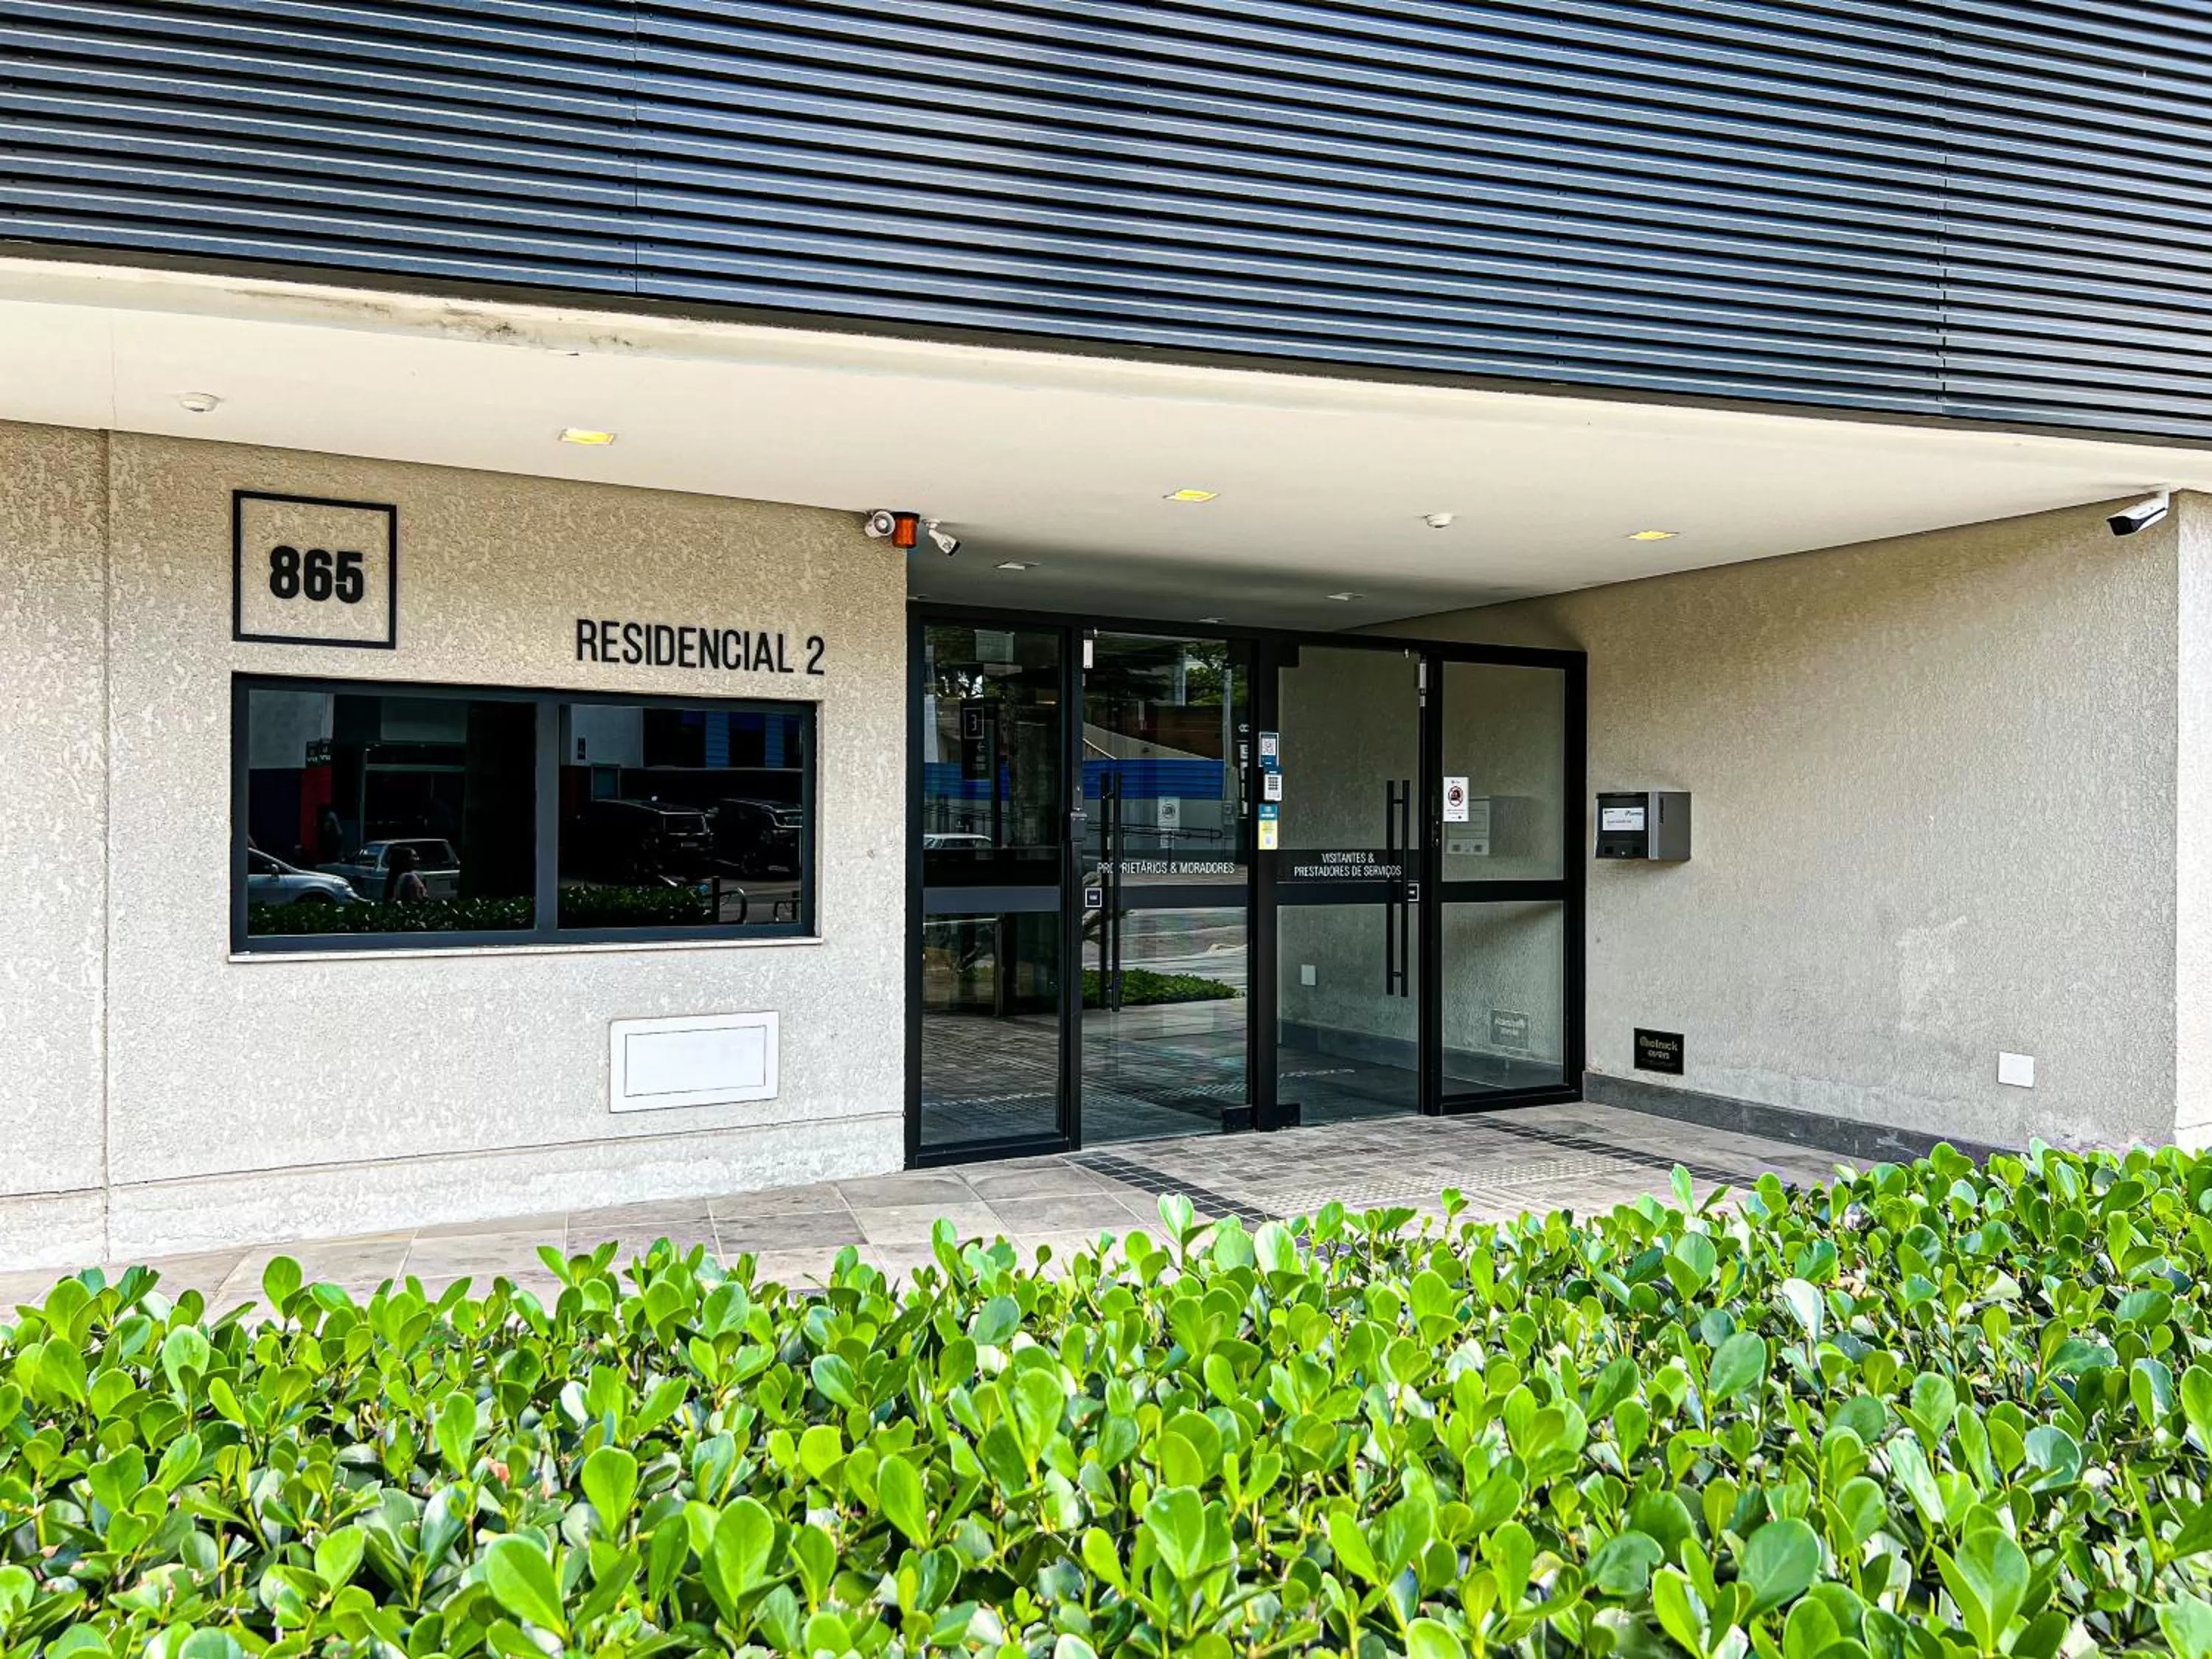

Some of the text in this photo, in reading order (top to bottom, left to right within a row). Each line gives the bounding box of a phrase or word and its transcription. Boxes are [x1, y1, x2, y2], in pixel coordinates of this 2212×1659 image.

[270, 546, 364, 604] 865
[577, 619, 825, 675] RESIDENCIAL 2
[1321, 852, 1375, 863] VISITANTES &
[1097, 860, 1235, 874] PRORIETÁRIOS & MORADORES
[1294, 865, 1402, 877] PRESTADORES DE SERVIÇOS
